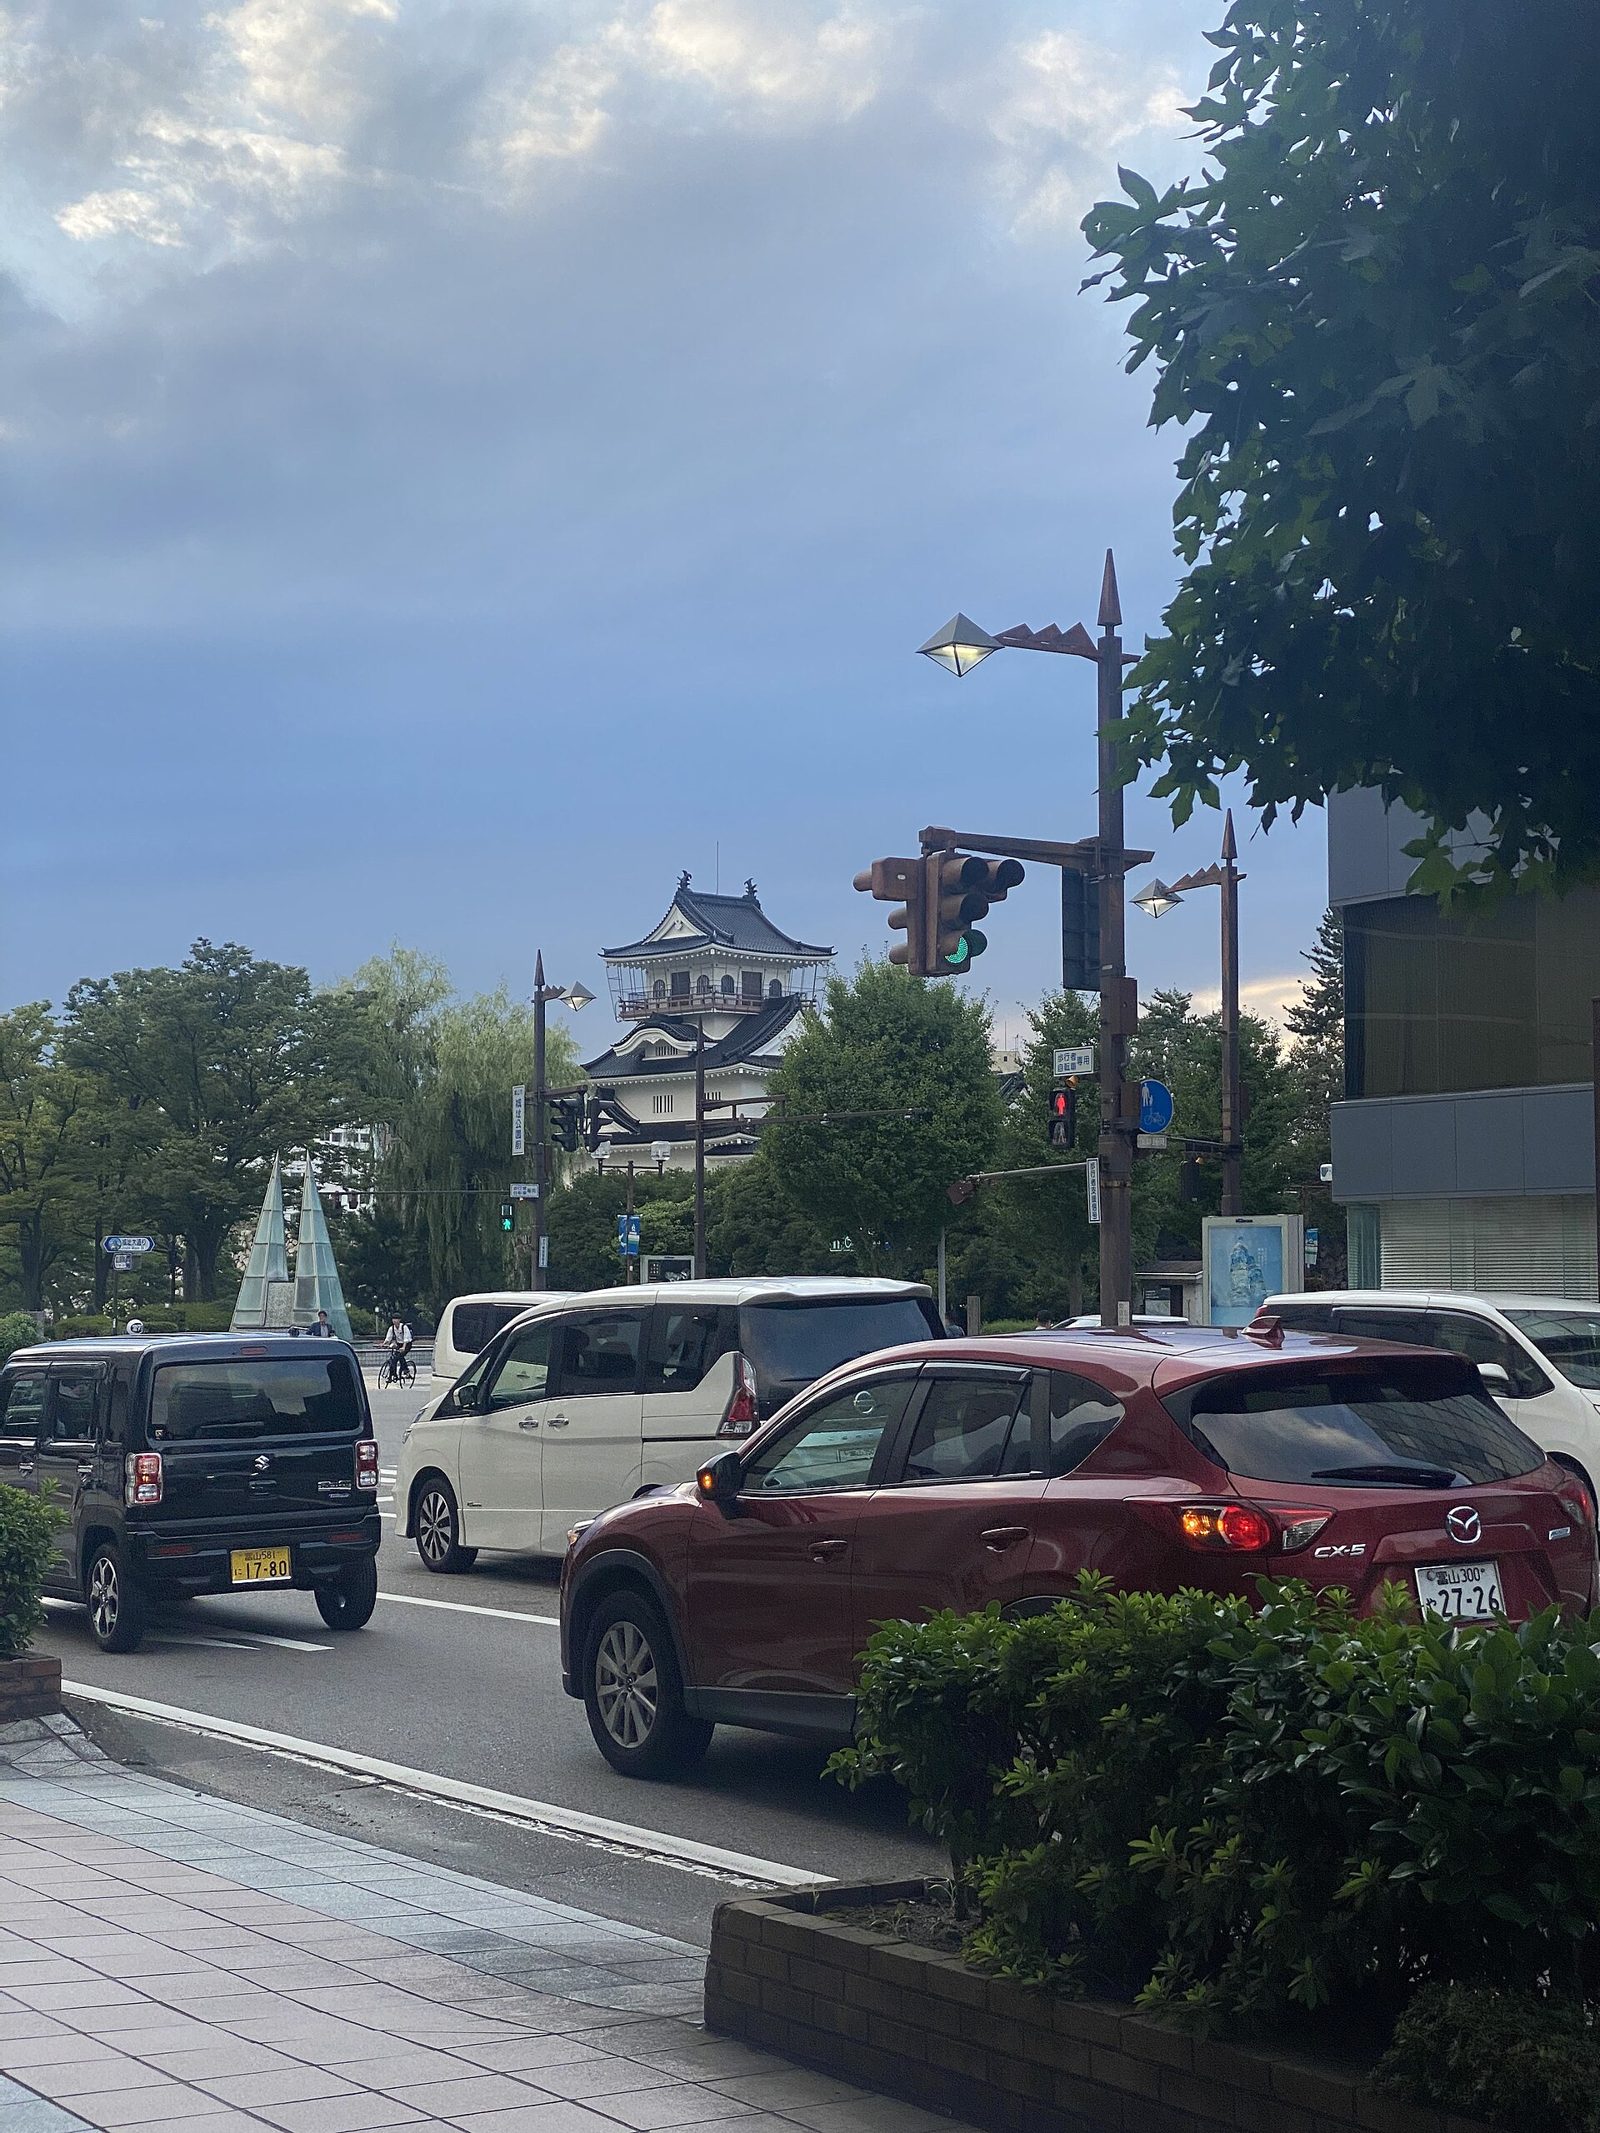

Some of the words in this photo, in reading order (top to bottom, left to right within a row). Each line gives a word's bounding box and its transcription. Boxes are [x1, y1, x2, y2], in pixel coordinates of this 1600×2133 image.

[1314, 1543, 1366, 1558] CX-5
[246, 1560, 287, 1579] 17-80
[1438, 1584, 1500, 1617] 27-26
